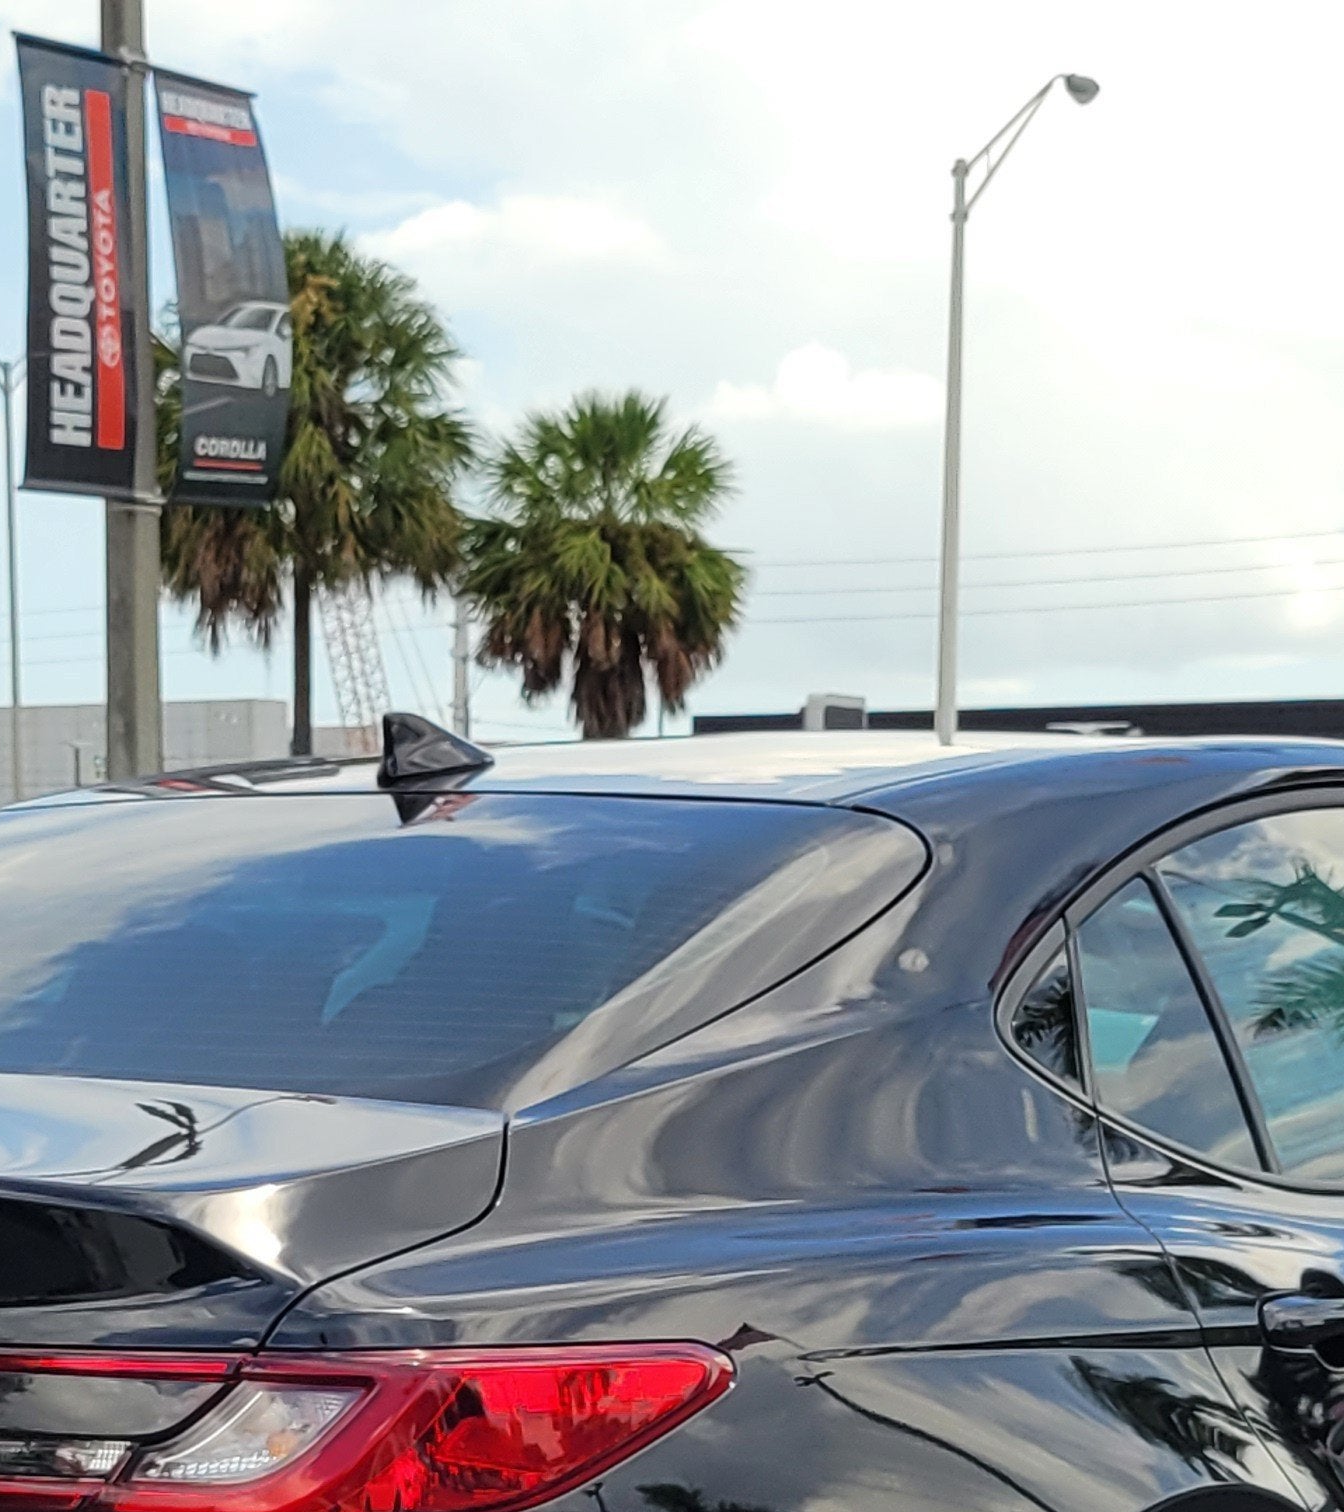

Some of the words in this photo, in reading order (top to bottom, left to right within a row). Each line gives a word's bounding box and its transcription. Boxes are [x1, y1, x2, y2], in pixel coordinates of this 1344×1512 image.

[41, 84, 96, 448] HEADQUARTER
[93, 189, 120, 319] TOYOTA
[194, 435, 267, 460] COROLLA
